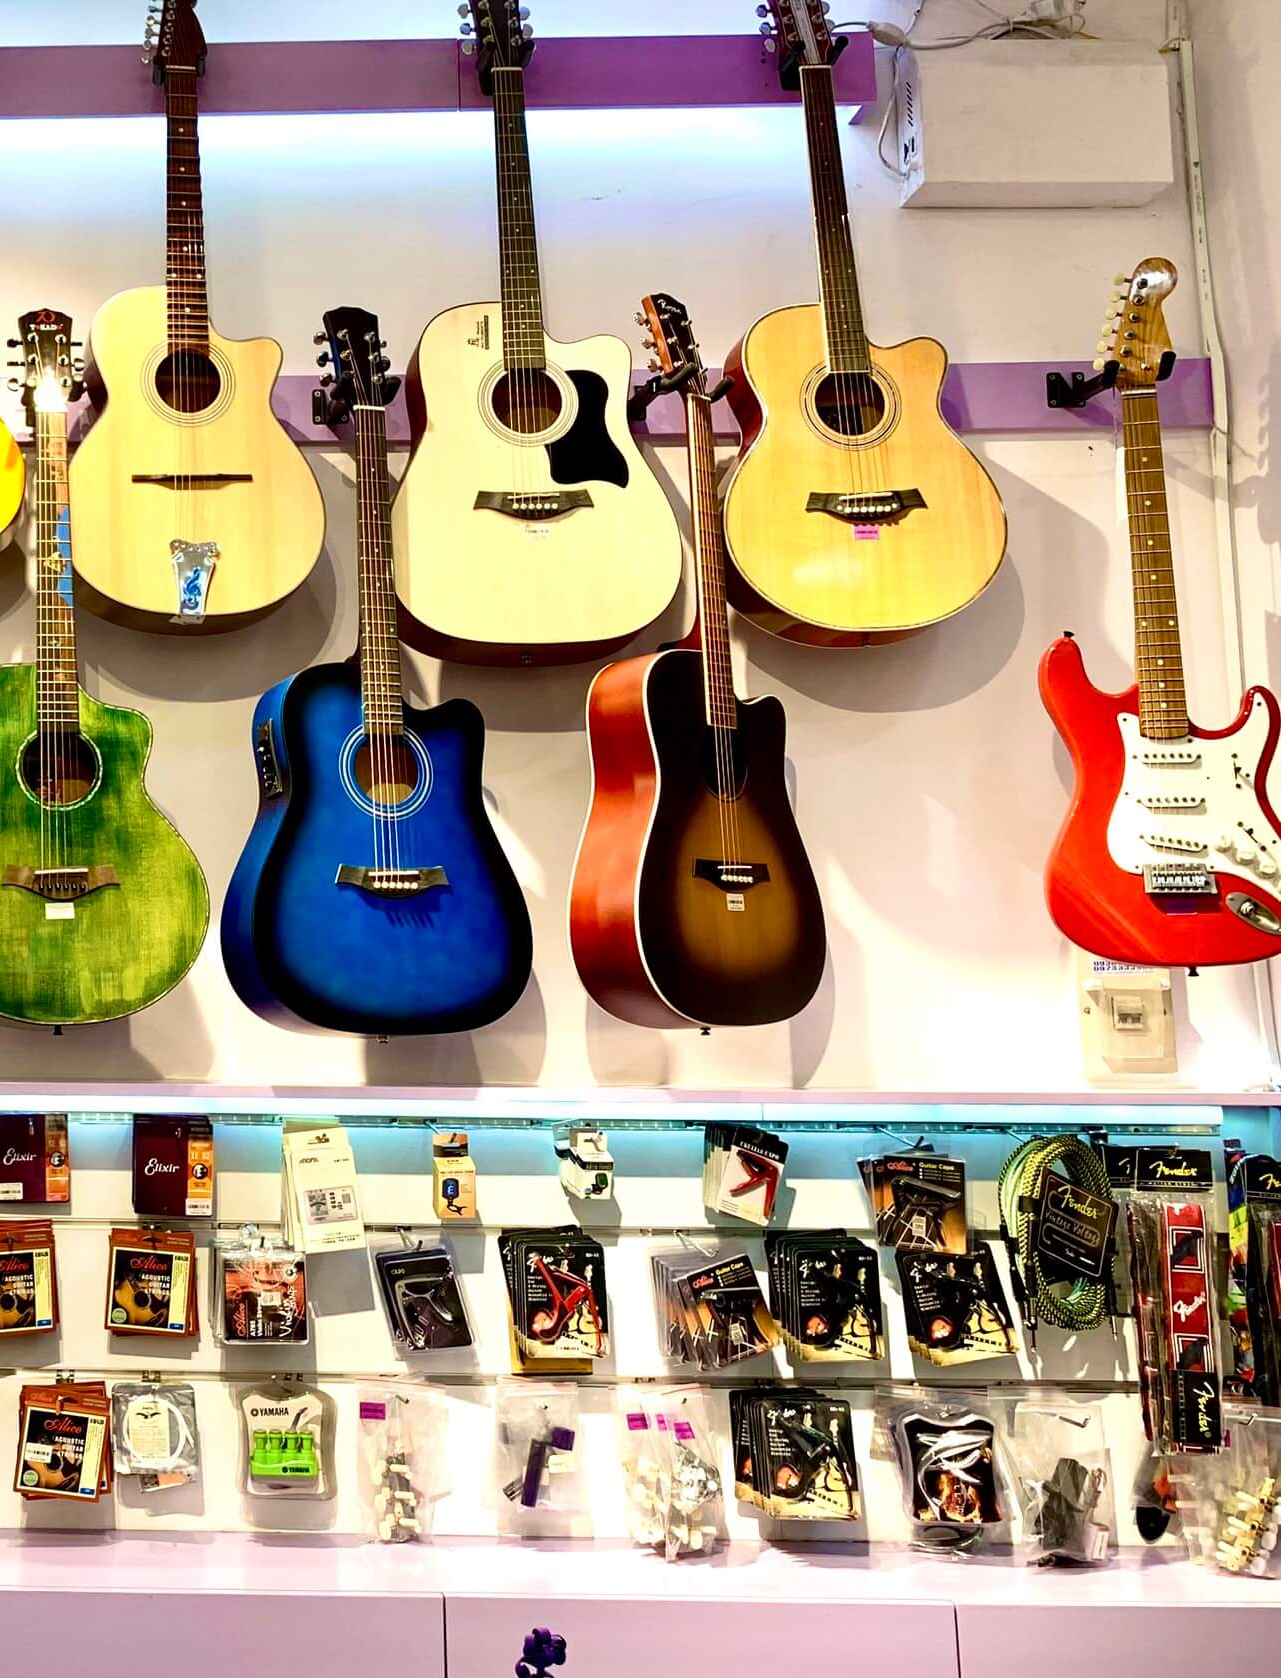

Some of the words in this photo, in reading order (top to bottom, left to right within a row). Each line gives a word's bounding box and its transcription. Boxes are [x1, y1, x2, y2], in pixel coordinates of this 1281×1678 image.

[3, 1148, 38, 1166] Elixir
[144, 1158, 180, 1176] Elixir
[1149, 1161, 1198, 1178] Fender
[1058, 1185, 1097, 1219] Fender
[130, 1255, 168, 1272] Alice
[4, 1274, 34, 1282] ACOUSTIC
[141, 1273, 171, 1282] ACOUSTIC
[232, 1303, 246, 1337] Alice
[259, 1407, 289, 1416] YAMAHA
[1192, 1381, 1215, 1433] Fender
[44, 1416, 82, 1434] Alice
[55, 1436, 85, 1446] ACOUSTIC
